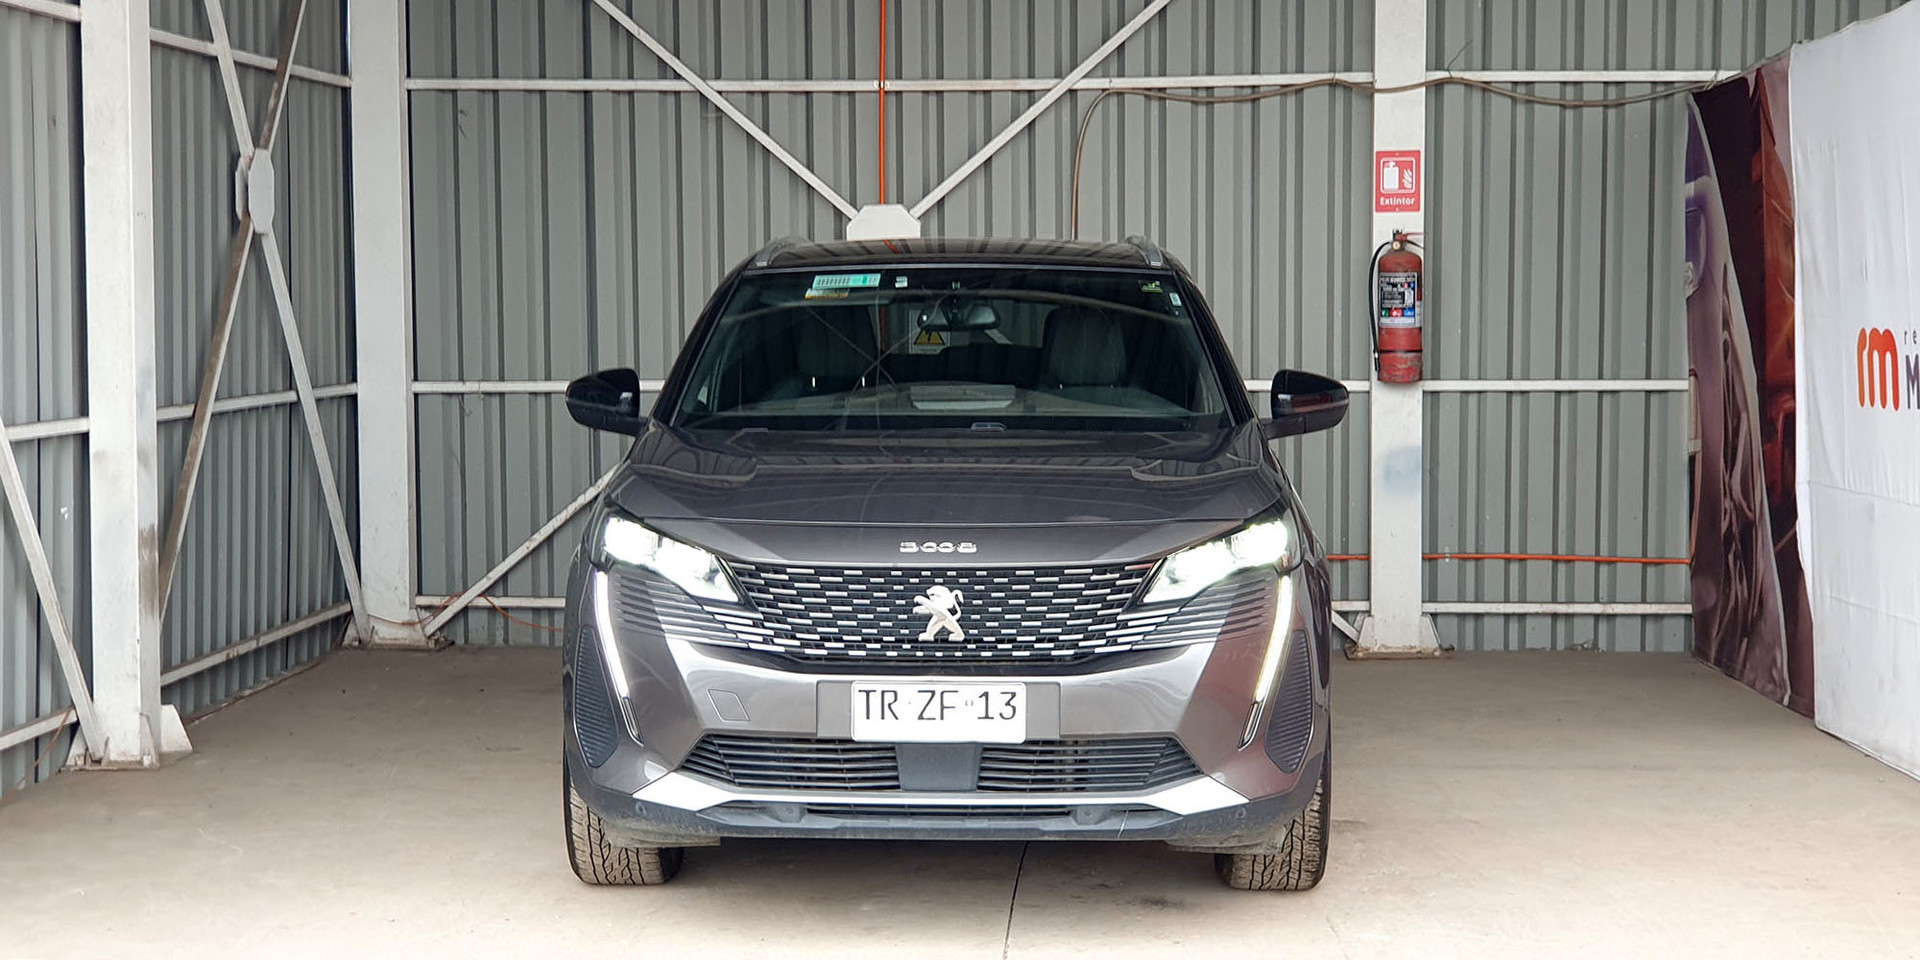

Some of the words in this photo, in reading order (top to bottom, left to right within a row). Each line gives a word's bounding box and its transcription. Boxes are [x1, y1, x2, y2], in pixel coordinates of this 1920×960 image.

[1379, 196, 1415, 206] Extintor
[899, 541, 978, 553] 3008
[857, 689, 899, 721] TR
[917, 689, 959, 721] ZF
[977, 690, 1017, 720] 13
